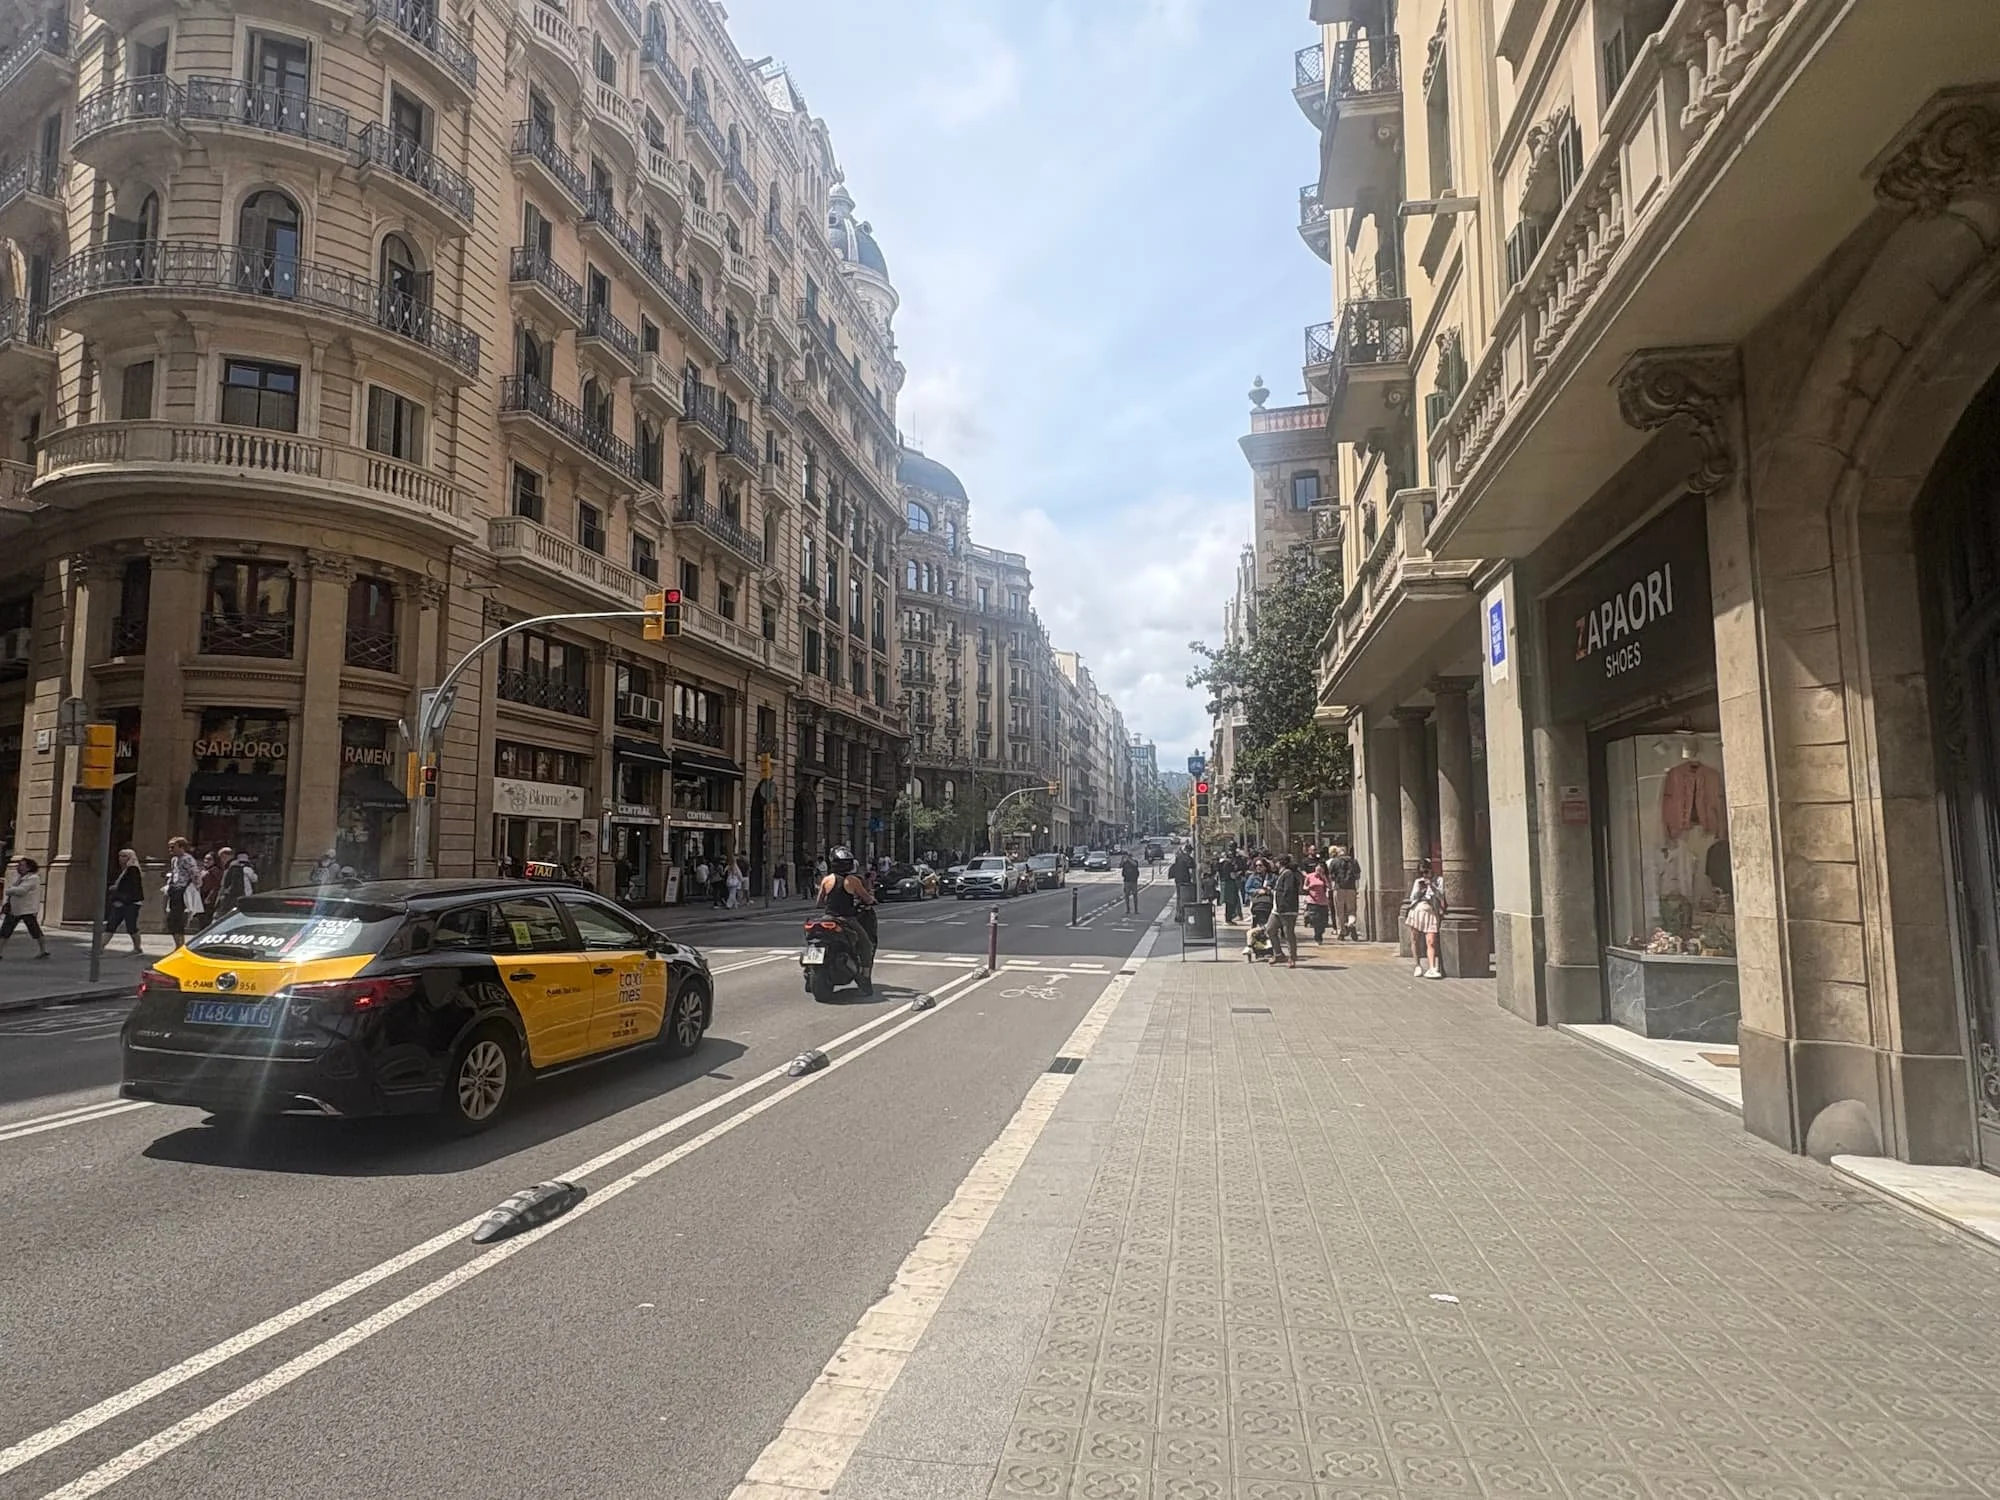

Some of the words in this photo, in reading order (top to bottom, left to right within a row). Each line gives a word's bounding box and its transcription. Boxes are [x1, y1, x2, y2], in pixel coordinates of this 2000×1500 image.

[1575, 562, 1673, 661] ZAPAORI
[1605, 641, 1642, 678] SHOES
[194, 739, 285, 758] SAPPORO
[344, 746, 392, 766] RAMEN
[618, 804, 652, 817] CENTRAL
[686, 811, 713, 822] CENTRAL
[534, 864, 553, 878] TAXI
[318, 918, 353, 929] taxi
[224, 934, 254, 945] 300
[253, 935, 286, 947] 300
[619, 972, 642, 987] taxi
